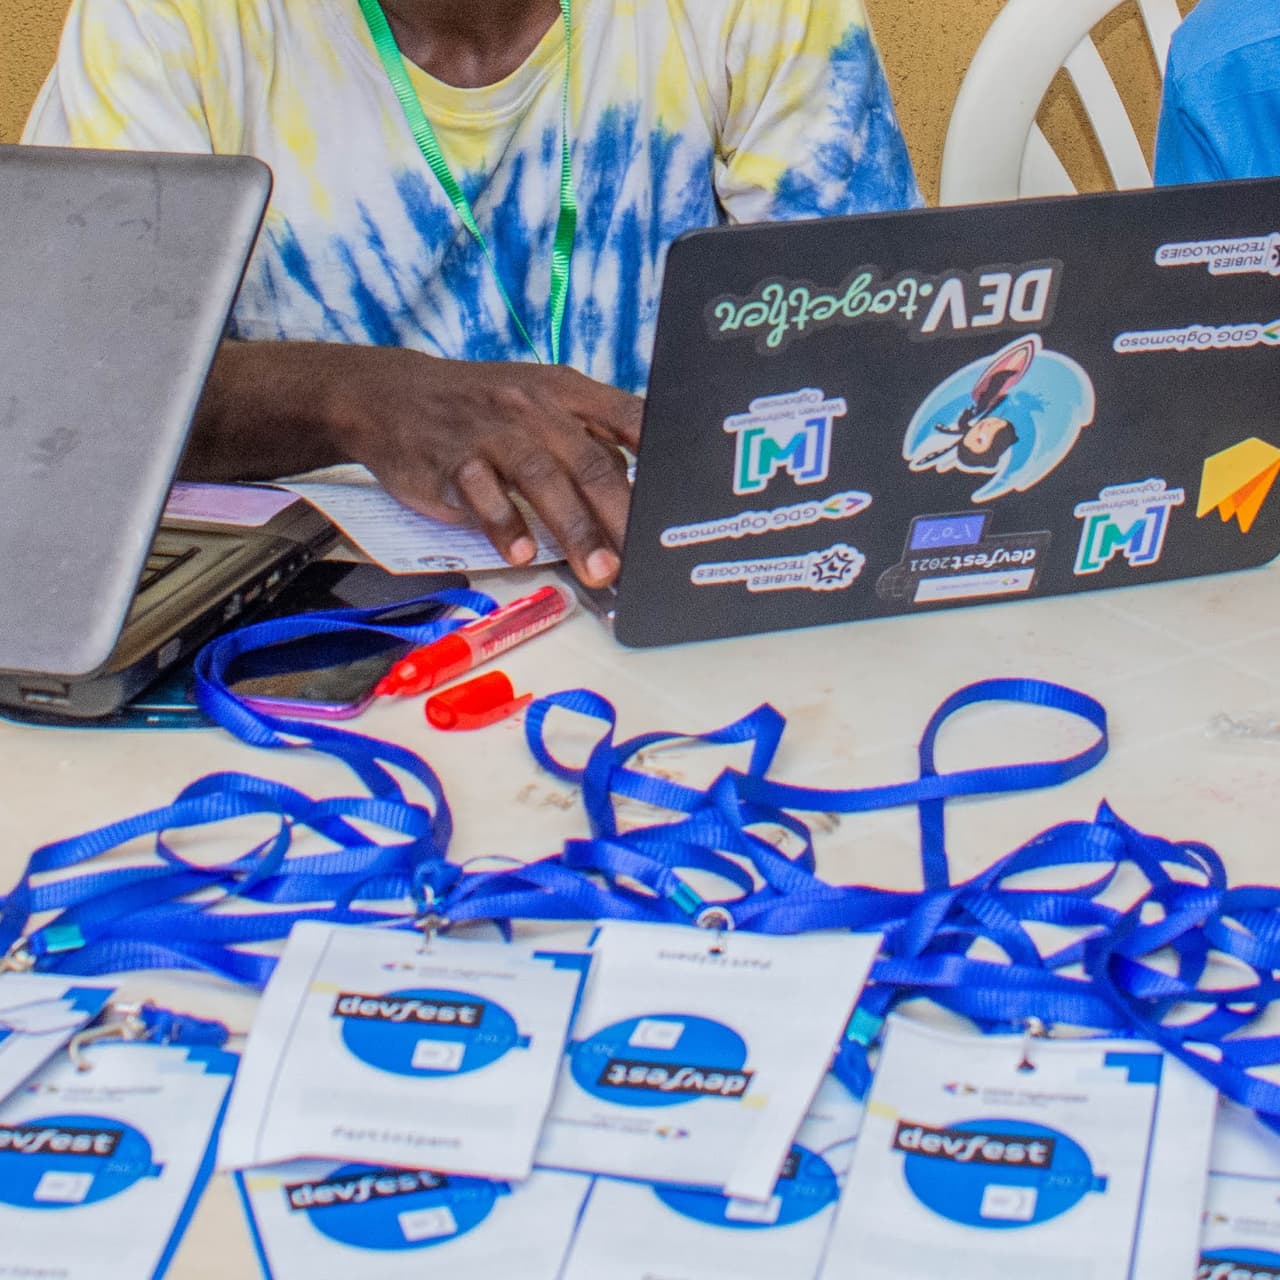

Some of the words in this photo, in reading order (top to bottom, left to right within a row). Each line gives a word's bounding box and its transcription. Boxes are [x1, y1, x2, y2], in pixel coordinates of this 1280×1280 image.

[1160, 241, 1266, 260] TECHNOLOGIES
[1213, 255, 1263, 268] RUBIES
[1120, 330, 1213, 348] Ogbomoso
[1216, 329, 1258, 342] GDG
[773, 507, 818, 525] GDG
[666, 516, 767, 543] Ogbomoso
[695, 559, 806, 579] TECHNOLOGIES
[751, 572, 804, 587] RUBIES
[338, 994, 478, 1025] devfest
[606, 1062, 749, 1096] devfest
[897, 1127, 1049, 1164] devfest
[290, 1170, 441, 1207] devfest
